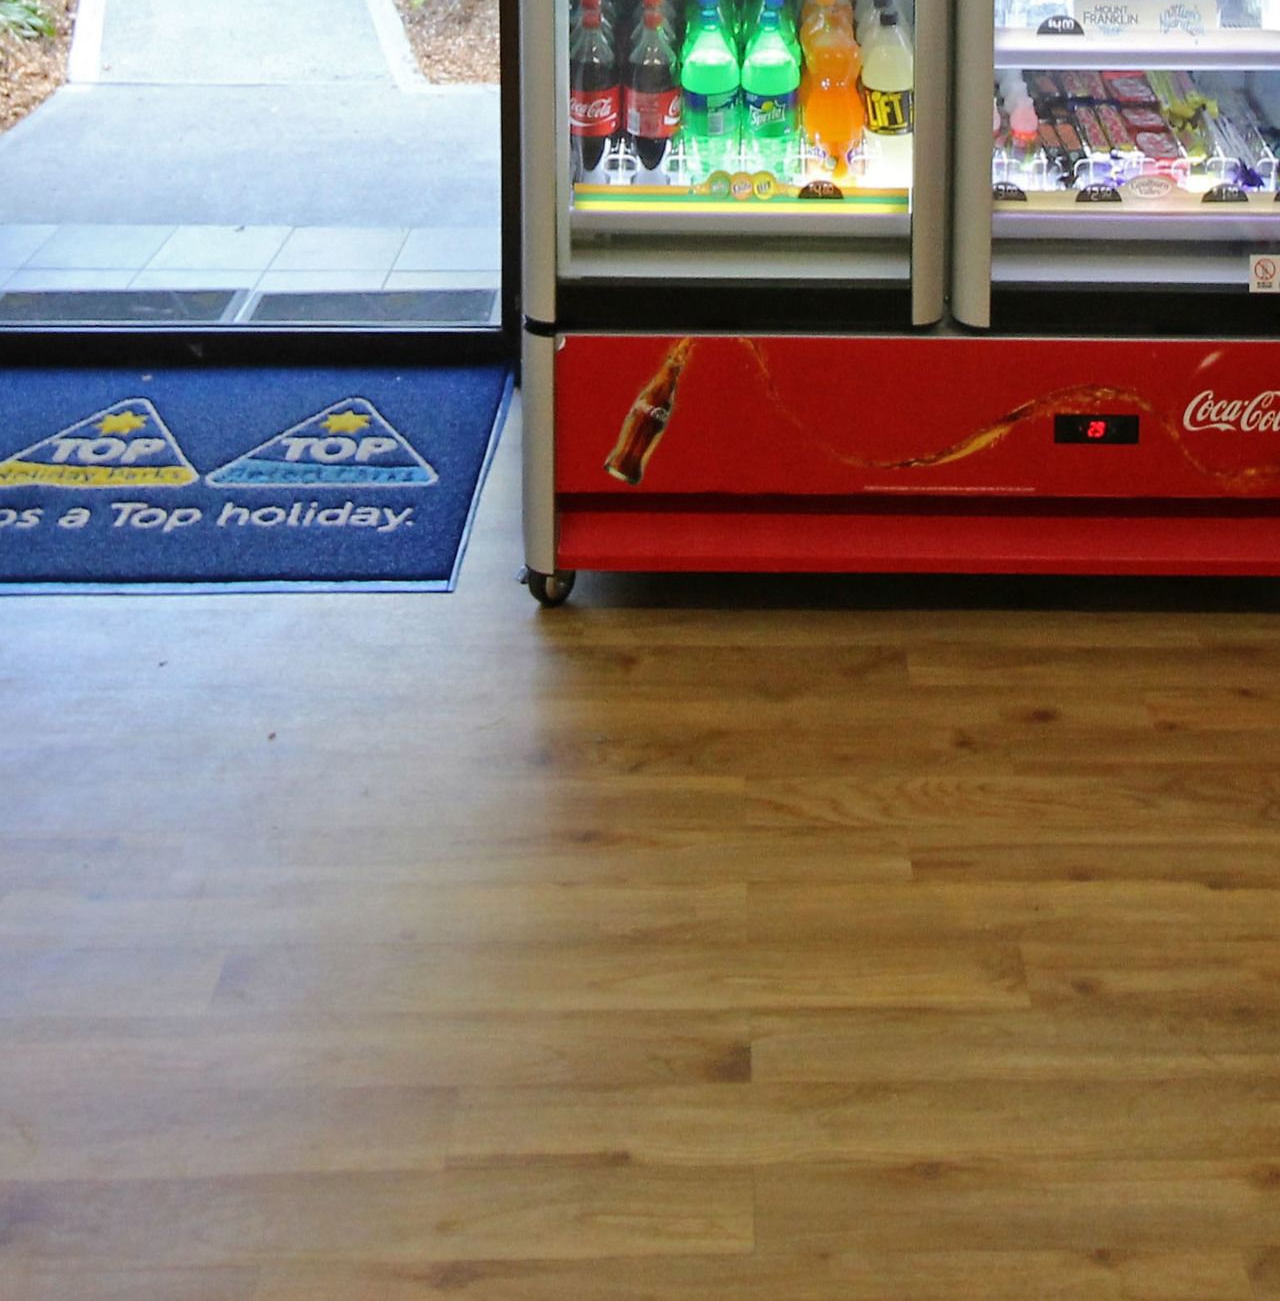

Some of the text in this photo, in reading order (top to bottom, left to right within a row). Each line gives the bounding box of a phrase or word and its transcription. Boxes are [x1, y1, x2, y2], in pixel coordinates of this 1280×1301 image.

[1083, 11, 1138, 26] FRANKLIN
[1094, 4, 1128, 15] MOUNT
[749, 106, 786, 125] Sprite
[51, 437, 167, 465] TOP
[281, 437, 399, 463] TOP
[58, 508, 91, 528] a
[111, 501, 202, 533] Top
[216, 501, 414, 533] holiday.
